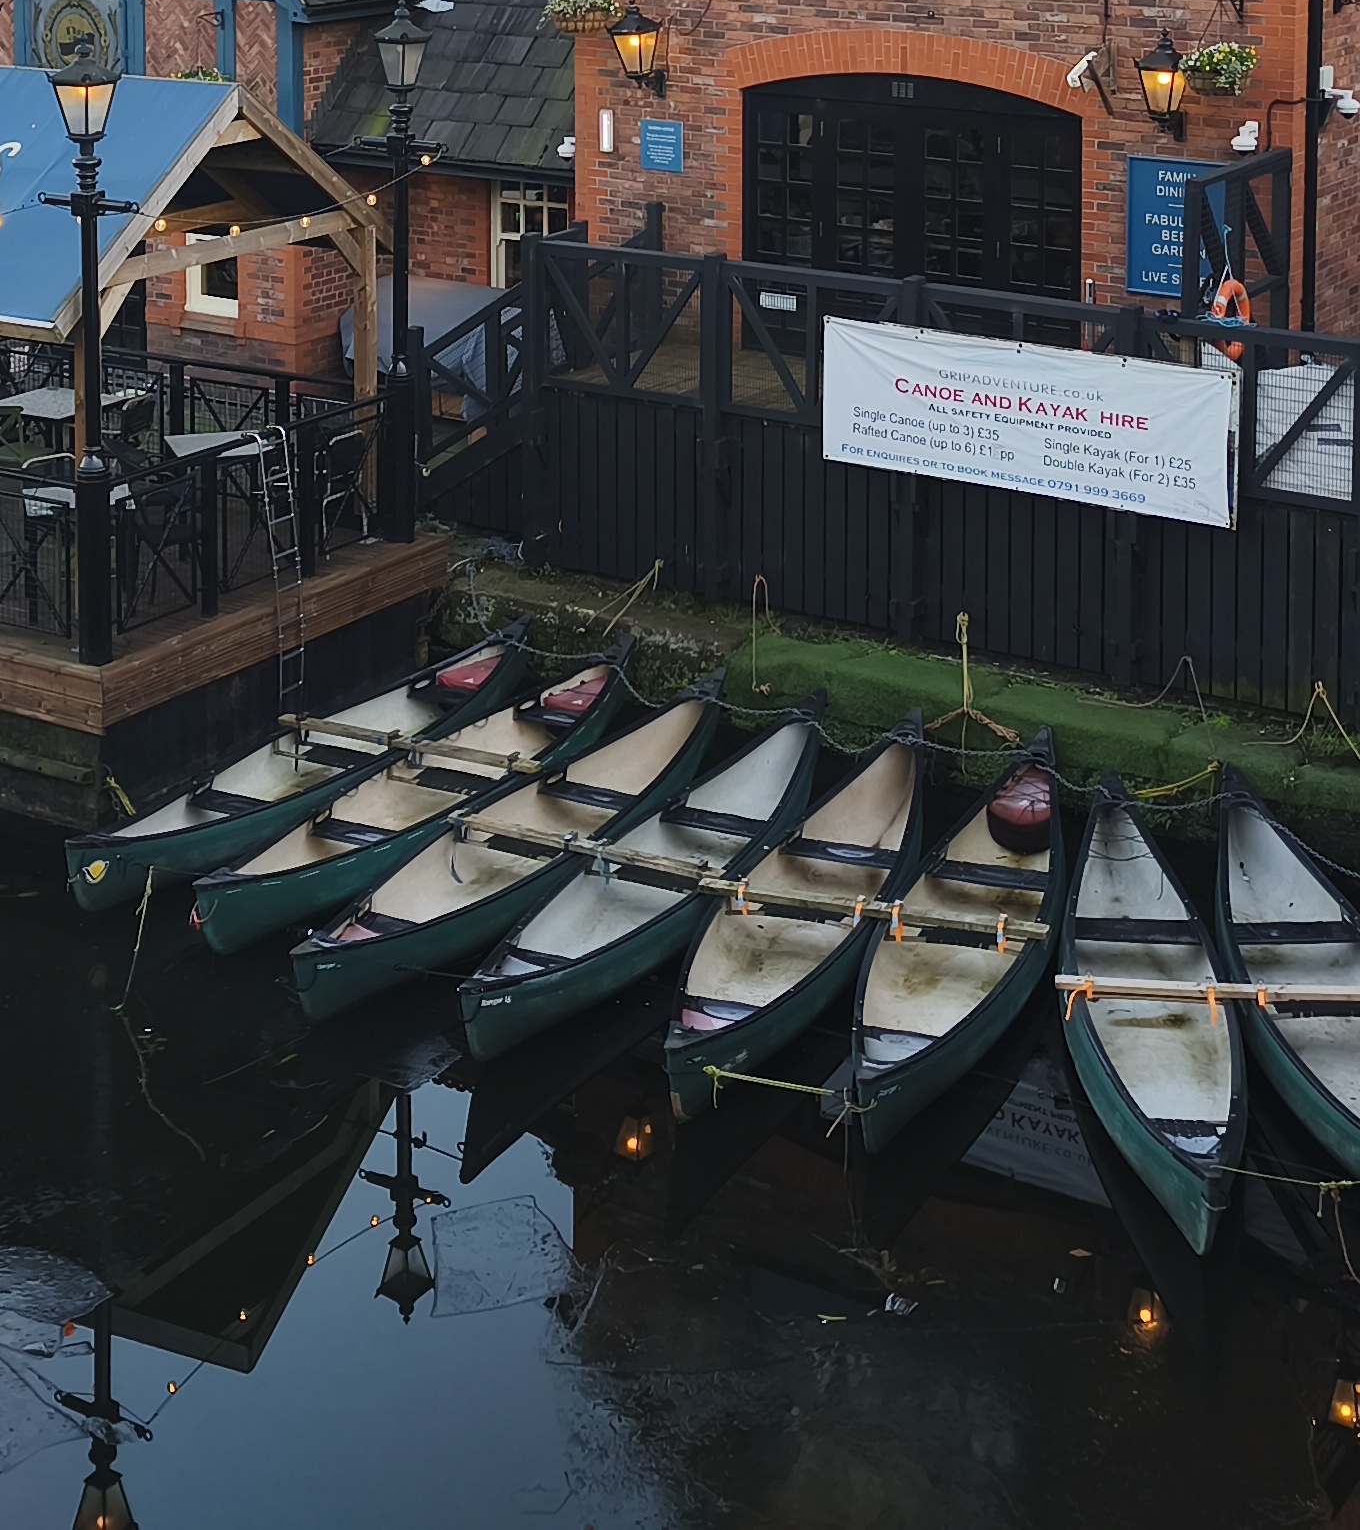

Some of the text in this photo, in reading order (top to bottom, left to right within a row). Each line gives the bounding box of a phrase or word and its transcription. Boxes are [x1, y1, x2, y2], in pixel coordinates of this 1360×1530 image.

[1142, 271, 1167, 284] LIVE
[895, 379, 1149, 430] CANOE AND KAYAK HIRE
[929, 403, 1111, 439] ALL SAFETY EQUIPMENT PROVIDED
[853, 406, 1000, 441] Single Canoe (up to 3) £35
[853, 423, 887, 439] Rafted
[891, 429, 927, 445] Canoe
[930, 437, 948, 451] (up
[951, 440, 961, 451] to
[964, 442, 976, 456] 6)
[1044, 438, 1192, 471] Single Kayak (For 1) £25
[841, 444, 1146, 504] FOR ENQUIRES OR TO BOOK MESSAGE 0791 999 3669
[1043, 455, 1196, 490] Double Kayak (For 2) £35
